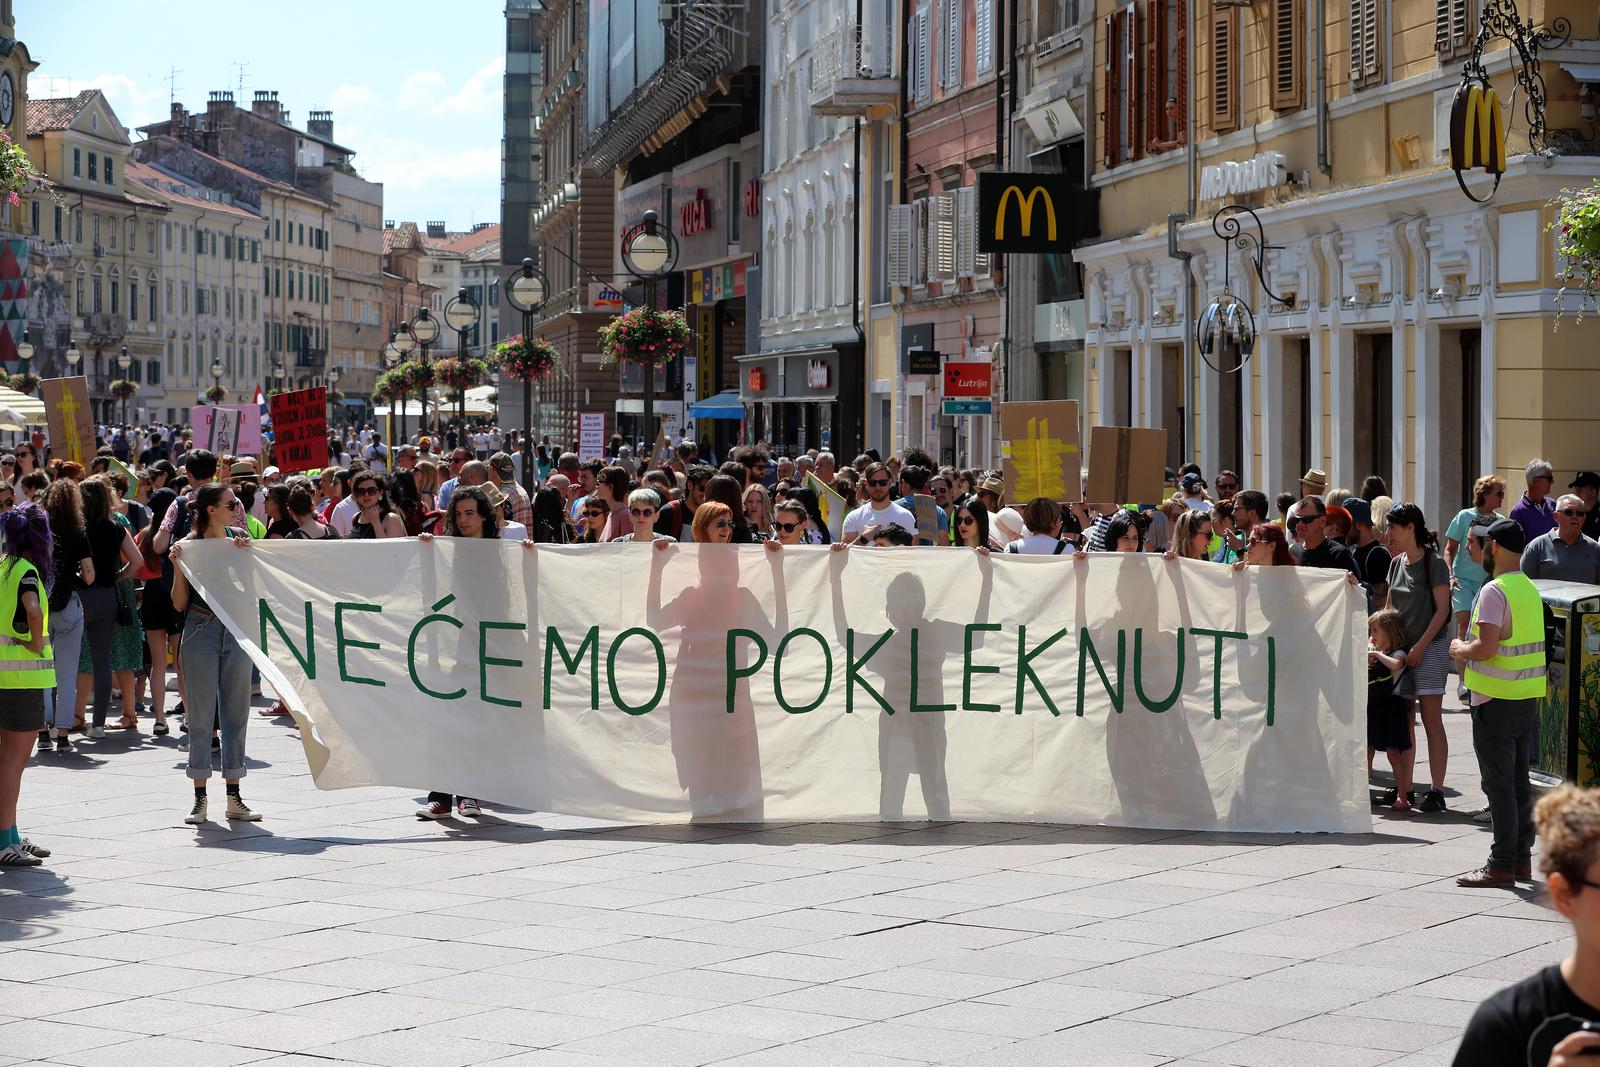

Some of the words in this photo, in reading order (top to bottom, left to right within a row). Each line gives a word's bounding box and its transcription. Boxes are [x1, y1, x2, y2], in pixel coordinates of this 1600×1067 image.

[599, 287, 620, 300] dm
[958, 379, 988, 389] Lutrija
[259, 594, 667, 716] NEĆEMO
[726, 624, 1276, 726] POKLEKNUTI
